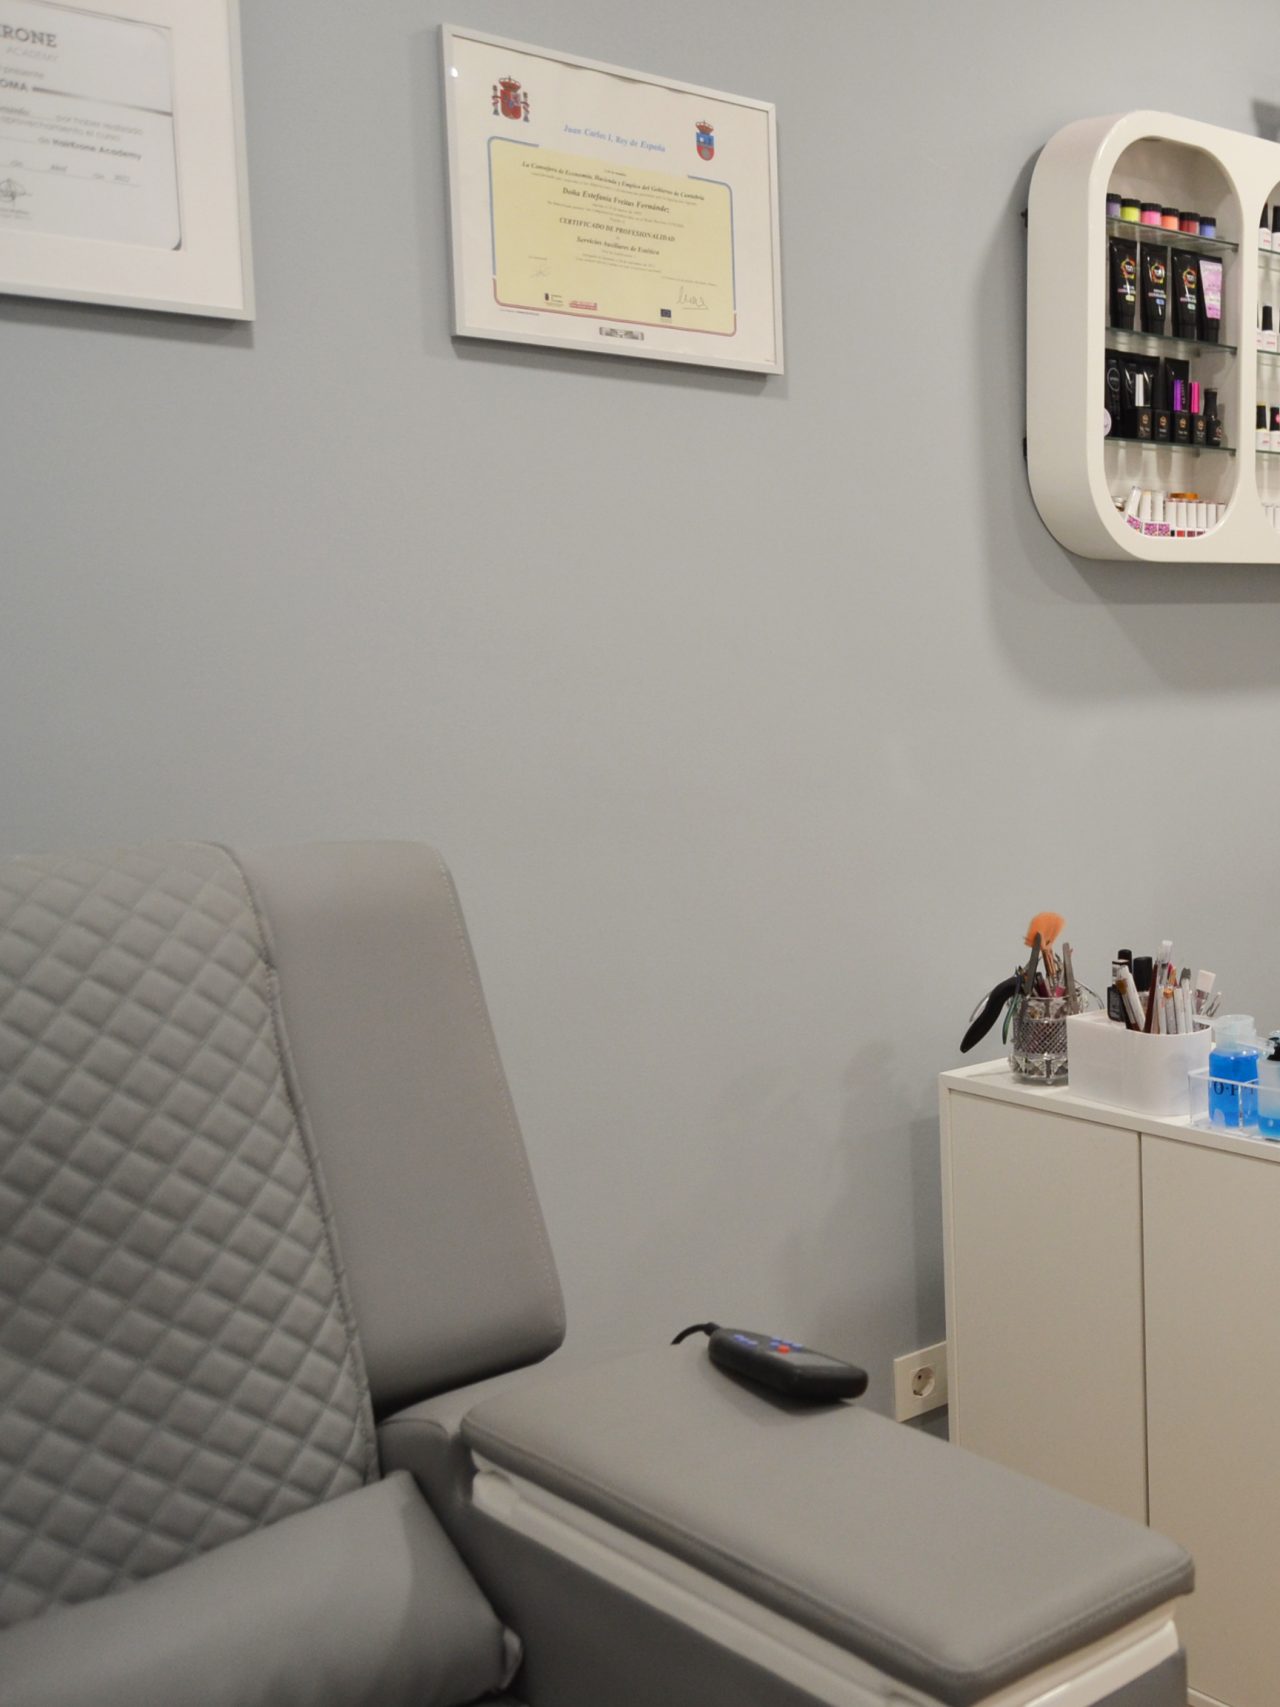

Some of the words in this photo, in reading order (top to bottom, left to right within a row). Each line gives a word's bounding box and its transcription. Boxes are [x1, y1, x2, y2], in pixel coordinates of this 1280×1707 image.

[0, 79, 29, 92] OMA
[563, 123, 581, 135] Juan
[584, 128, 606, 140] Carlos
